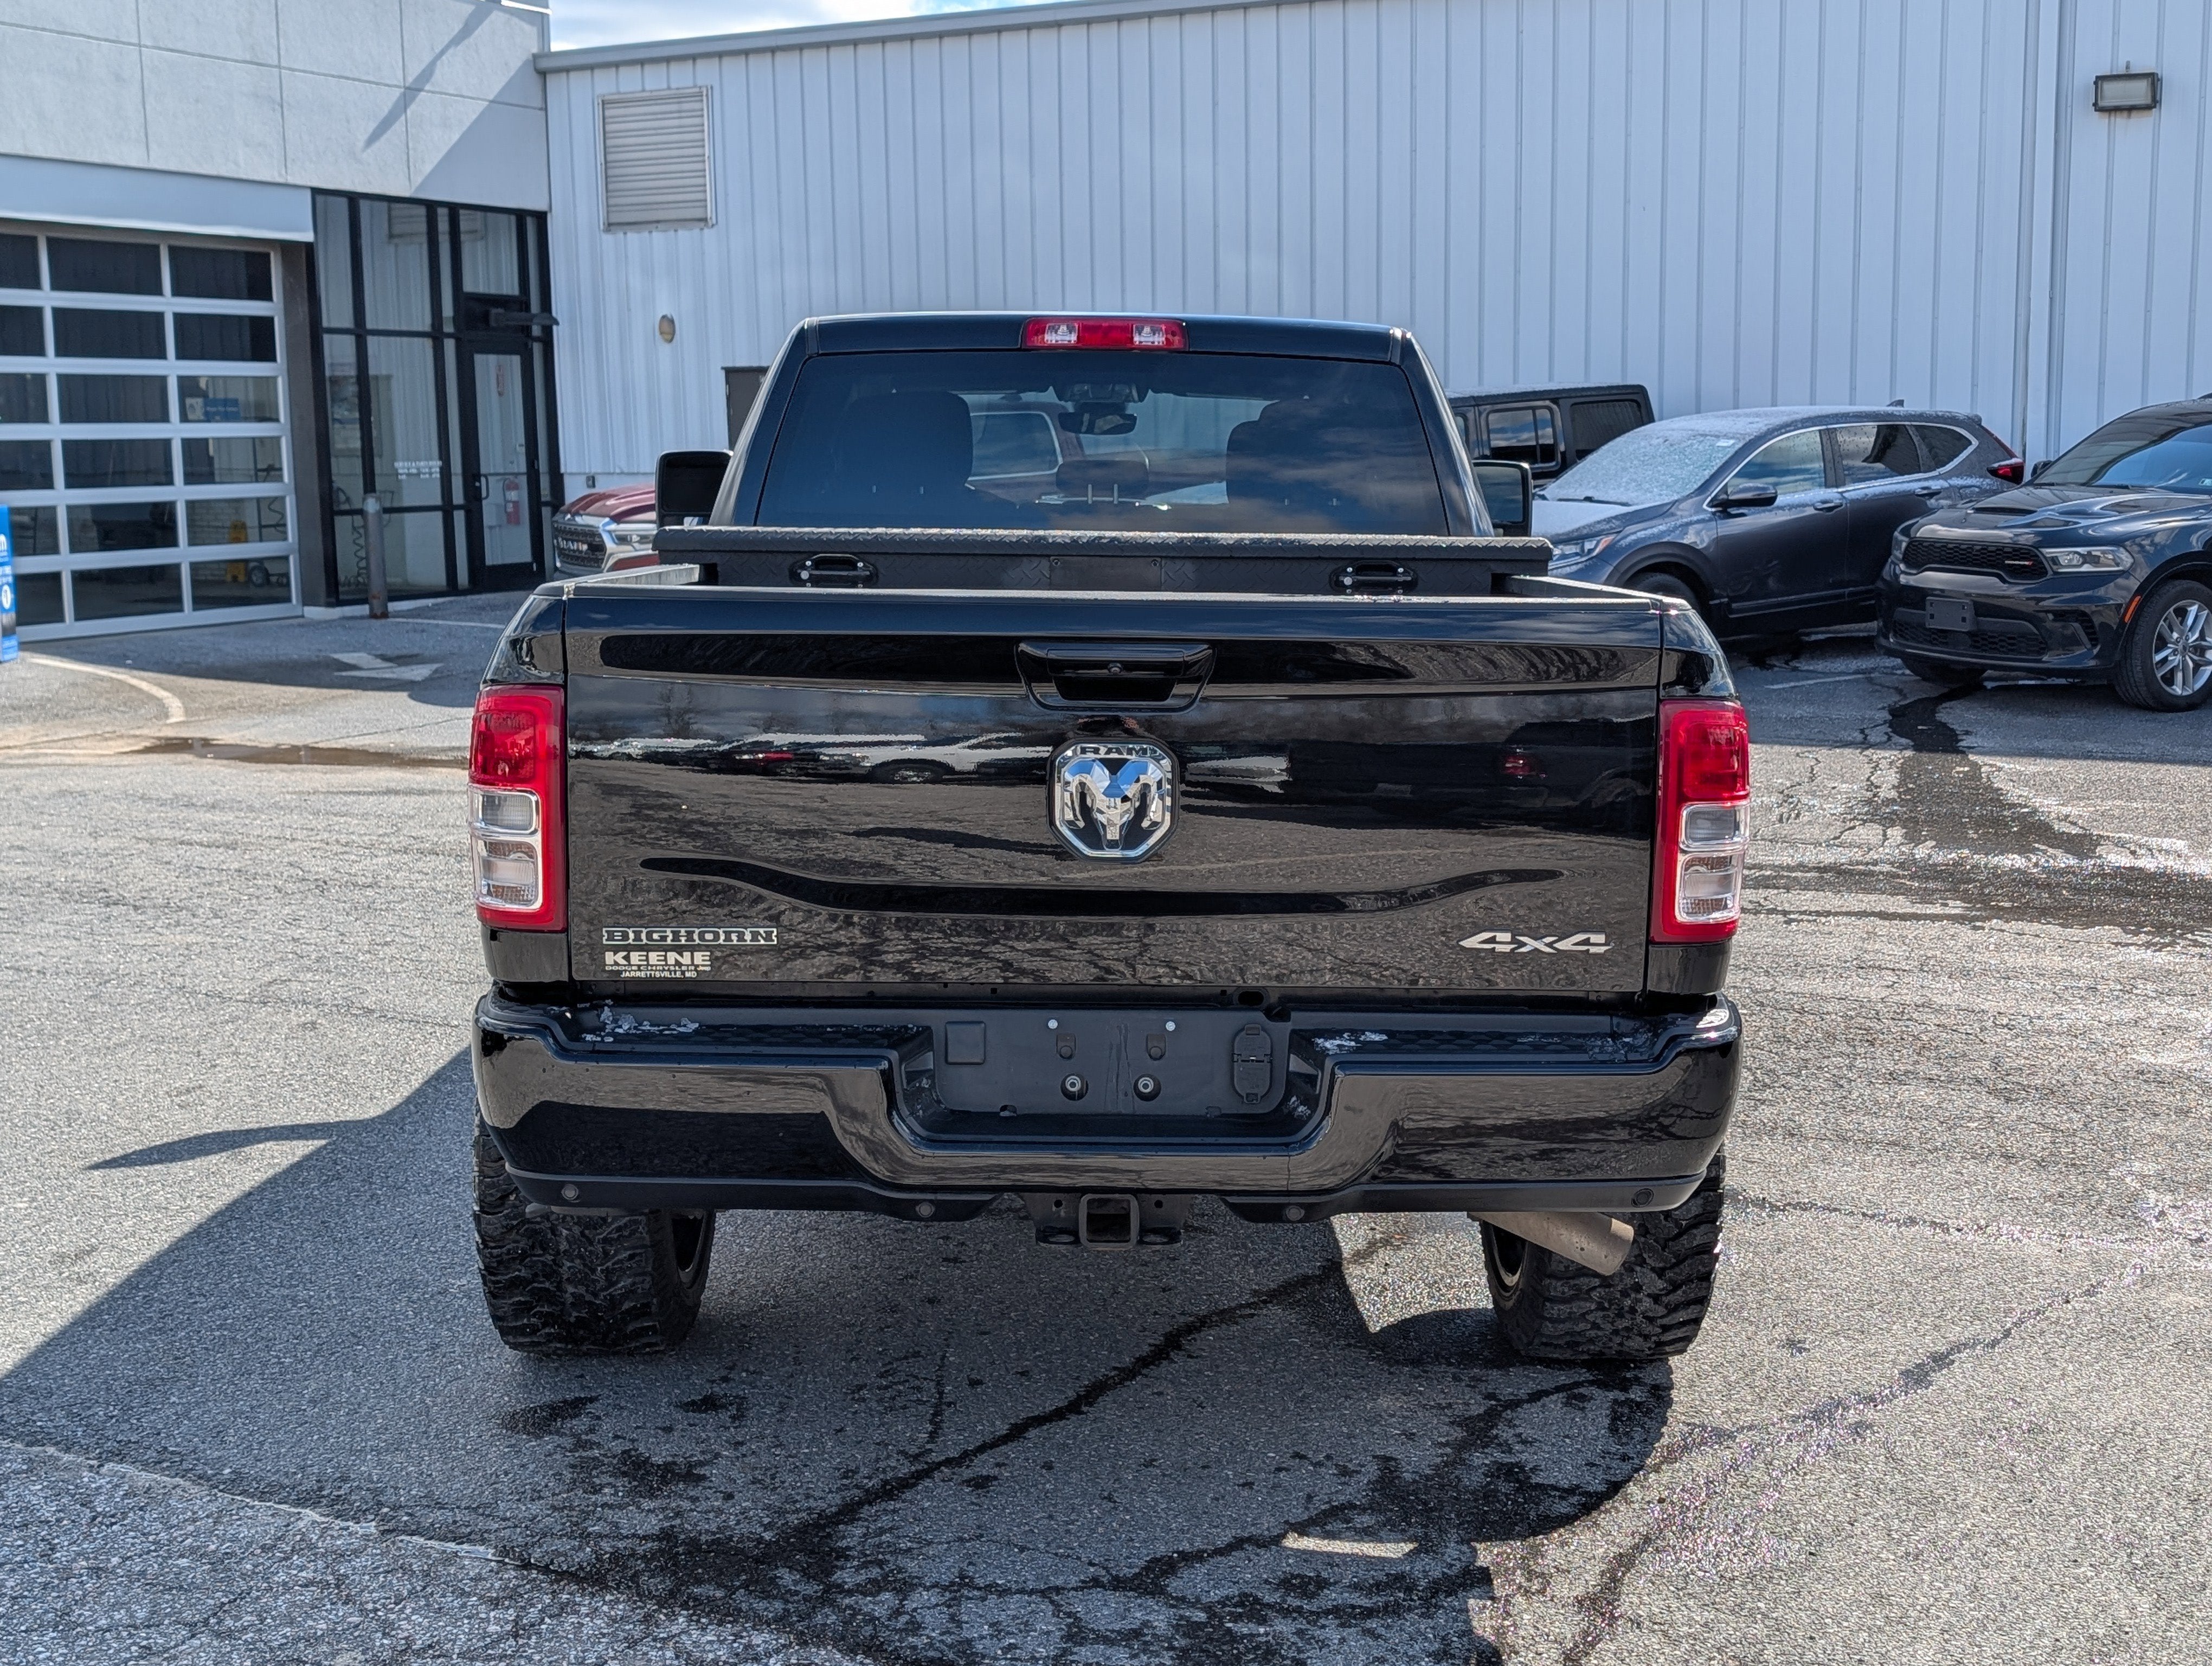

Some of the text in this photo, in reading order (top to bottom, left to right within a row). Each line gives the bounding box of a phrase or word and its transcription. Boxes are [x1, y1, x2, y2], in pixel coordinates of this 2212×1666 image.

[1080, 746, 1148, 756] RAM
[602, 927, 777, 945] BIGHORN
[1458, 930, 1613, 954] 4x4
[605, 951, 711, 965] KEENE
